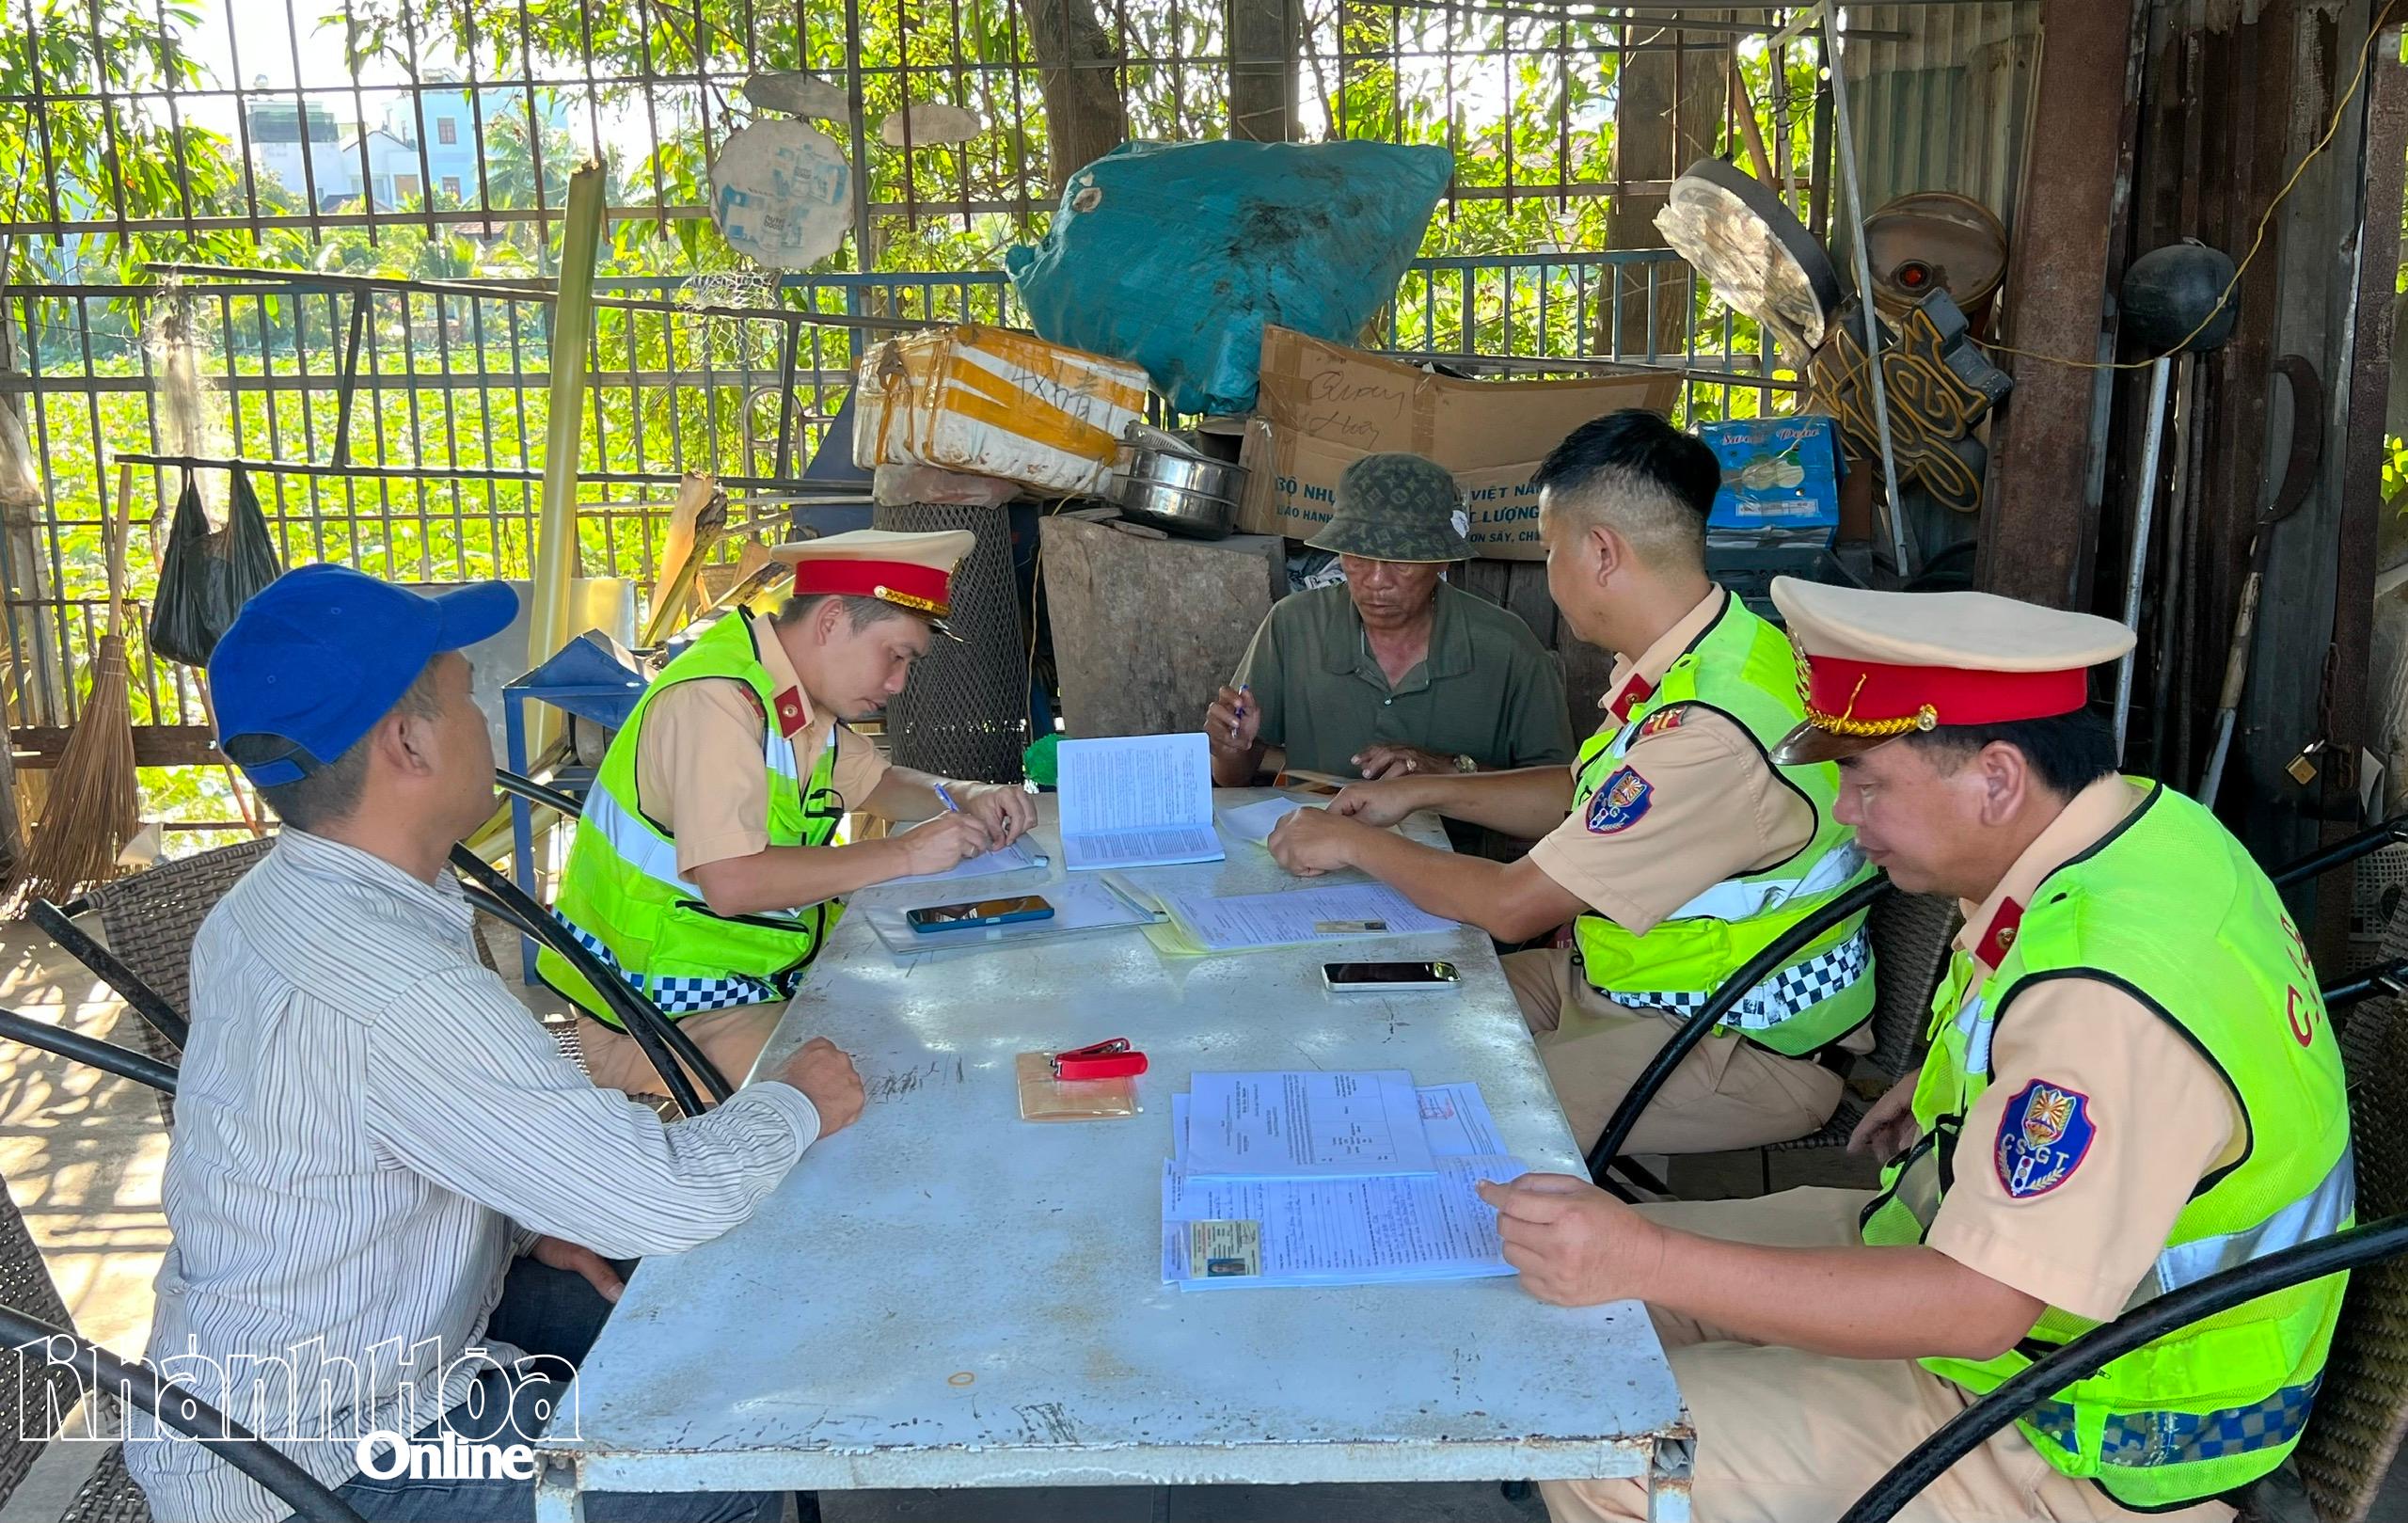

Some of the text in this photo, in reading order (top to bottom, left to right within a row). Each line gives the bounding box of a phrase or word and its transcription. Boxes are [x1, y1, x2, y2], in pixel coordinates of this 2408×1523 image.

[1470, 484, 1509, 501] VIỆT
[1482, 505, 1539, 524] LƯỢNG
[2002, 1134, 2069, 1168] CSGT
